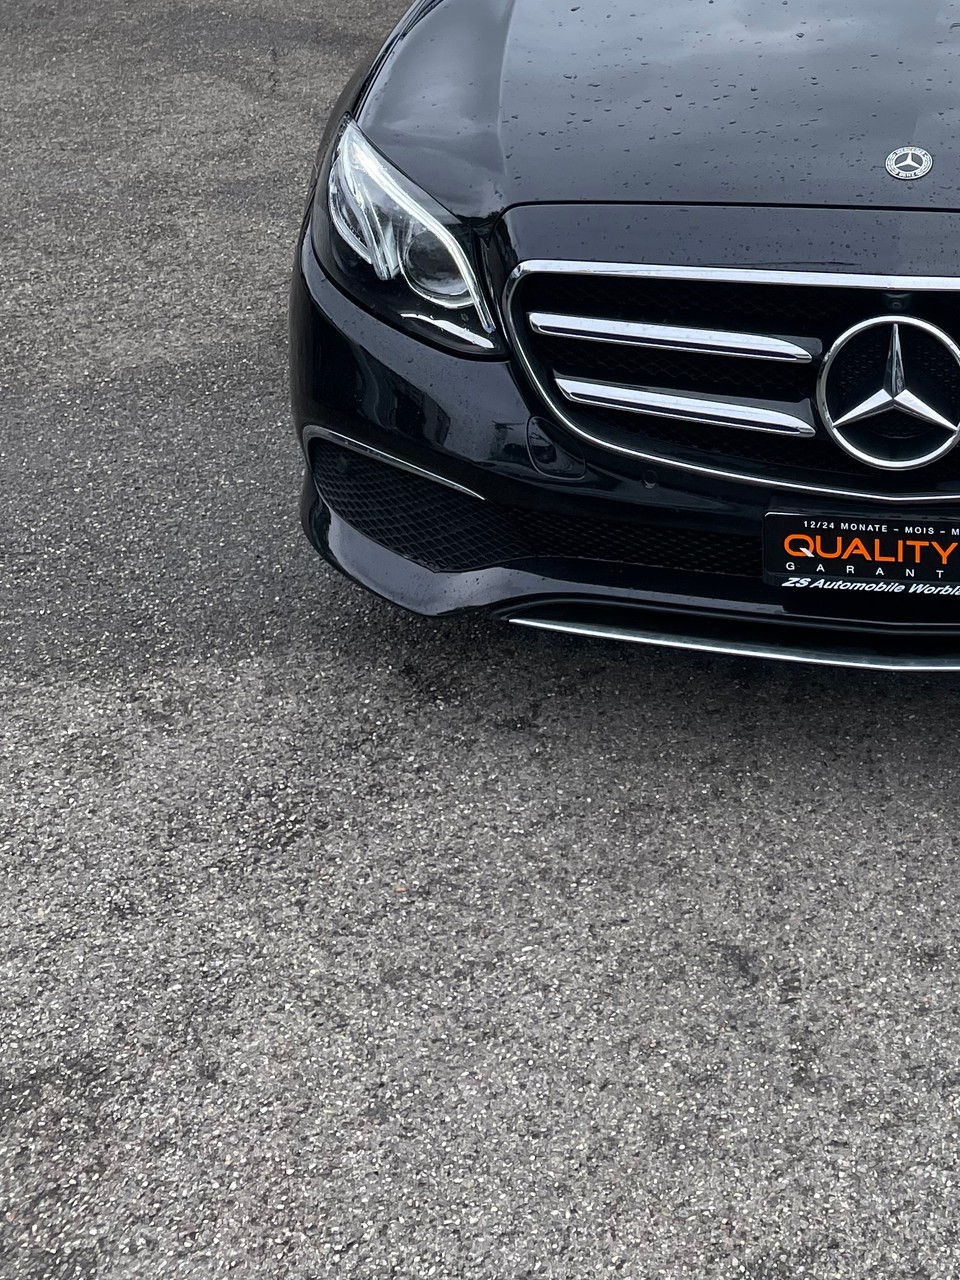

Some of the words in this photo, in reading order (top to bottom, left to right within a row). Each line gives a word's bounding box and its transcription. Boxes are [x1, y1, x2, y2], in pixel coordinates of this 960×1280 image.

[803, 520, 835, 529] 12/24
[840, 523, 888, 533] MONATE
[904, 526, 935, 535] MOIS
[783, 533, 959, 565] QUALITY
[781, 577, 812, 589] ZS
[809, 579, 905, 594] Automobile
